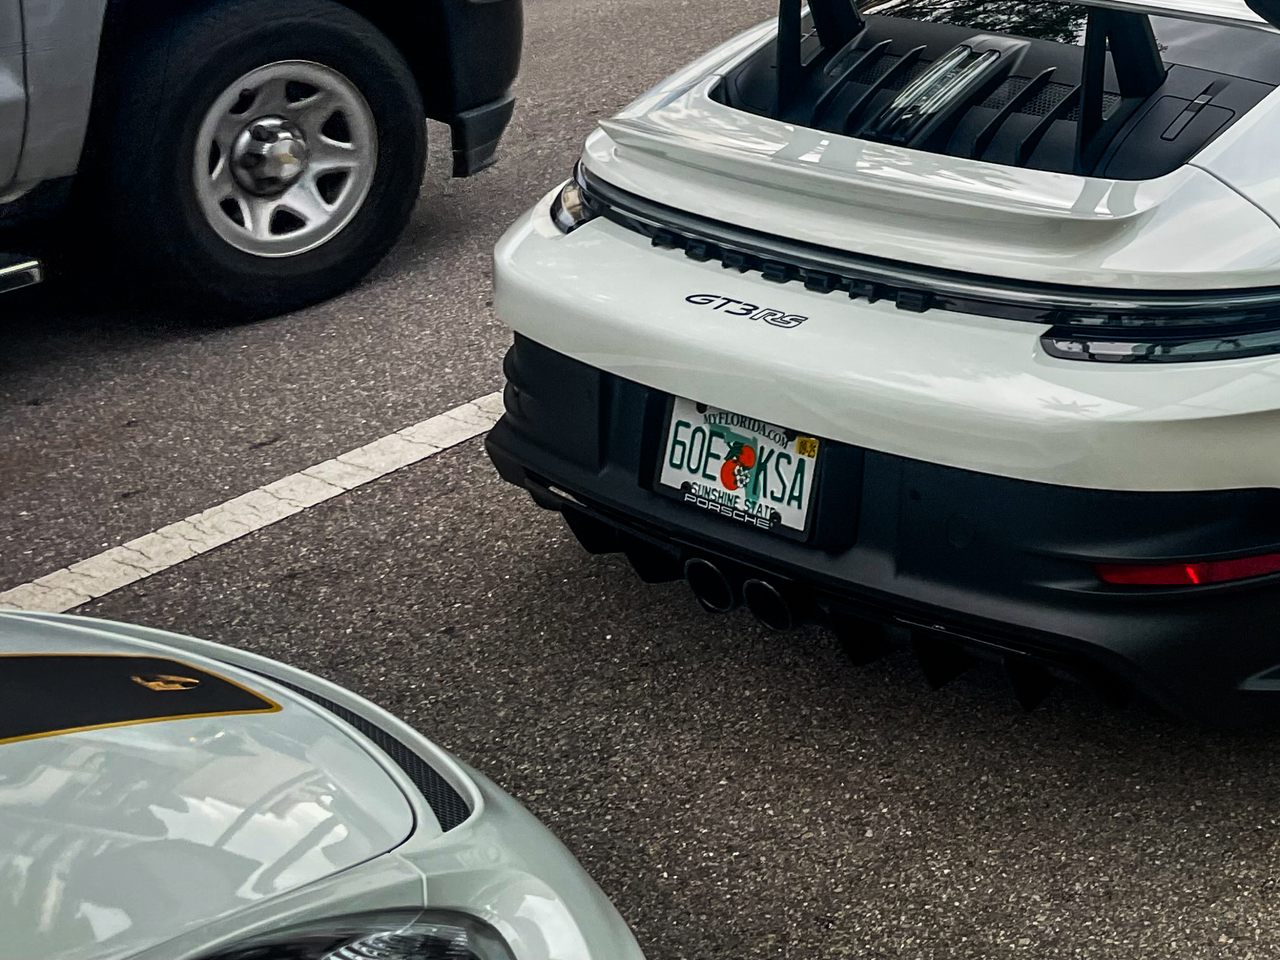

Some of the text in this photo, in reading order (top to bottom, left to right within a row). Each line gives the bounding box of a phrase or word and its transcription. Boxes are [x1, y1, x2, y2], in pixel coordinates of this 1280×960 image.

[691, 482, 741, 509] SUNSHINE
[752, 445, 806, 510] KSA
[684, 493, 771, 530] PORSCHE
